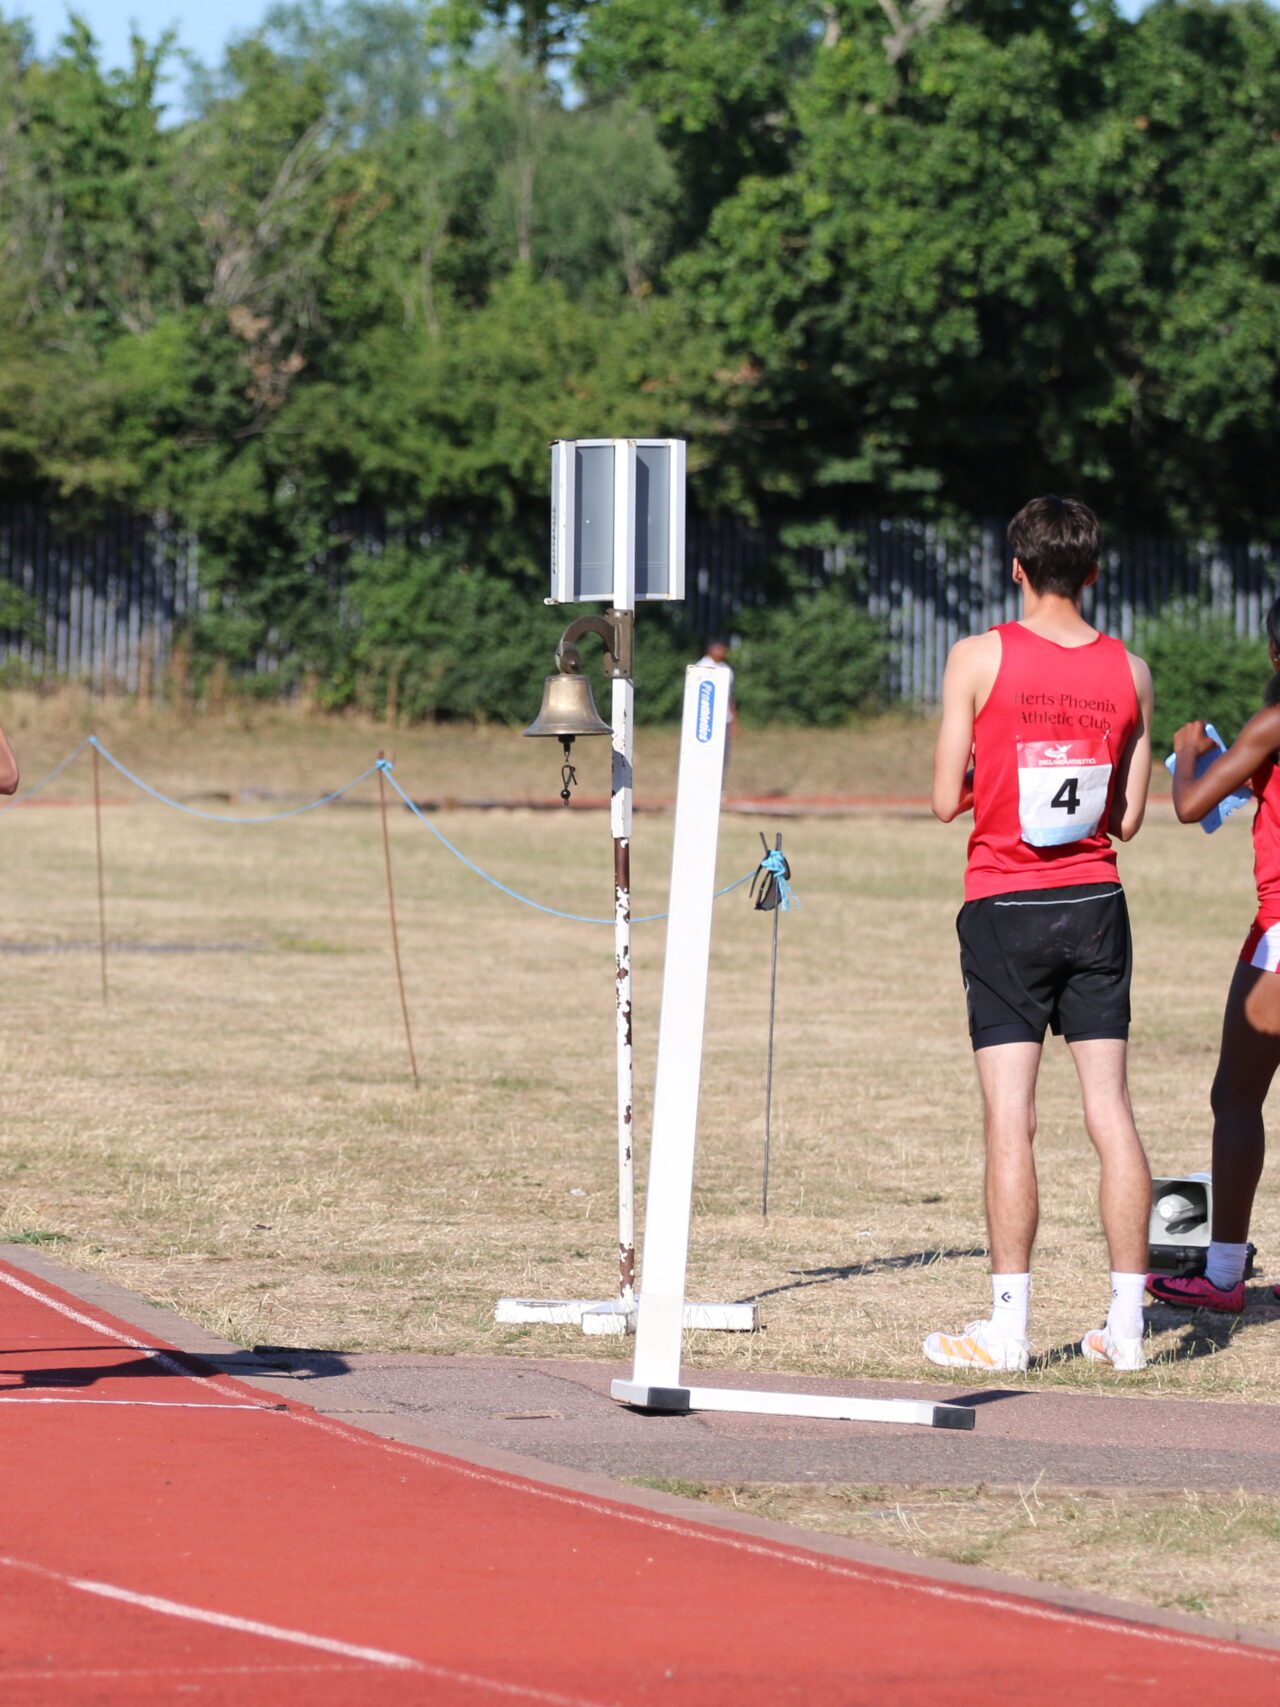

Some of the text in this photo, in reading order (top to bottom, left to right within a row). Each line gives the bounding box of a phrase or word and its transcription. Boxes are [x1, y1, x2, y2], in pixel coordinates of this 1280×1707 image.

[1014, 692, 1117, 713] Herts Phoenix
[1019, 712, 1111, 730] Athletic Club
[1050, 777, 1080, 815] 4
